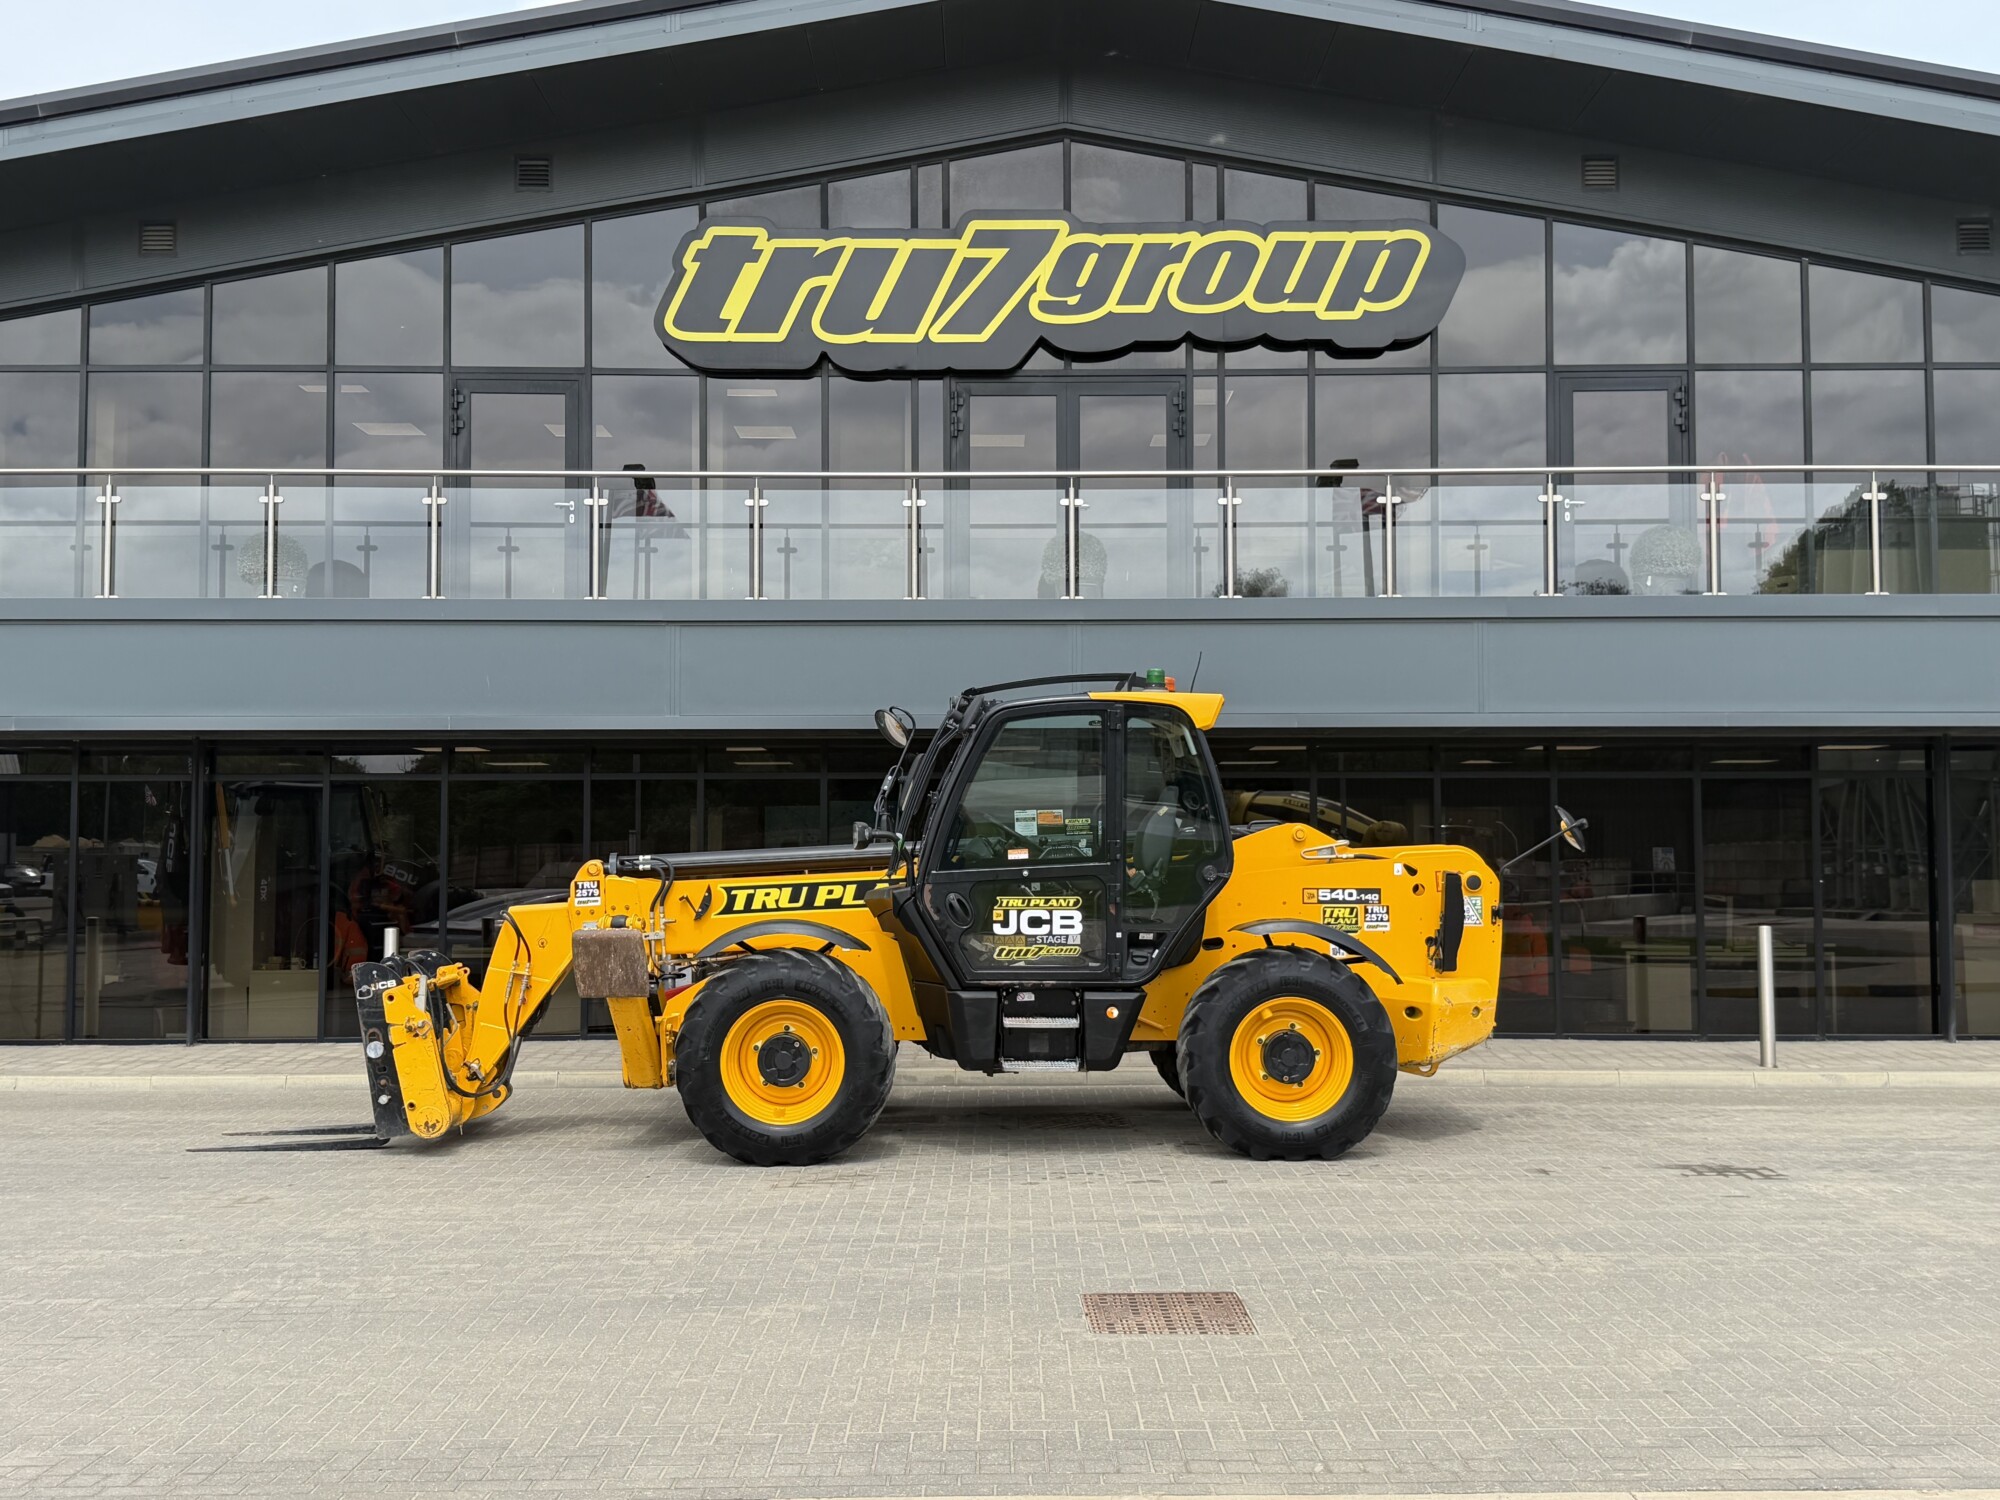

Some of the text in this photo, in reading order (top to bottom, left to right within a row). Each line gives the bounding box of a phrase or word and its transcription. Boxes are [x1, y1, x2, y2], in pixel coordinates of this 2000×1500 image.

[576, 881, 598, 889] TRU
[575, 889, 600, 897] 2579
[1318, 889, 1379, 901] 540-140
[730, 886, 809, 911] TRU
[1001, 898, 1077, 907] TRU PLANT
[1324, 907, 1357, 918] TRU
[1366, 906, 1387, 914] TRU
[993, 910, 1083, 935] JCB
[1036, 936, 1067, 944] STAGE
[995, 945, 1082, 960] tru7.com
